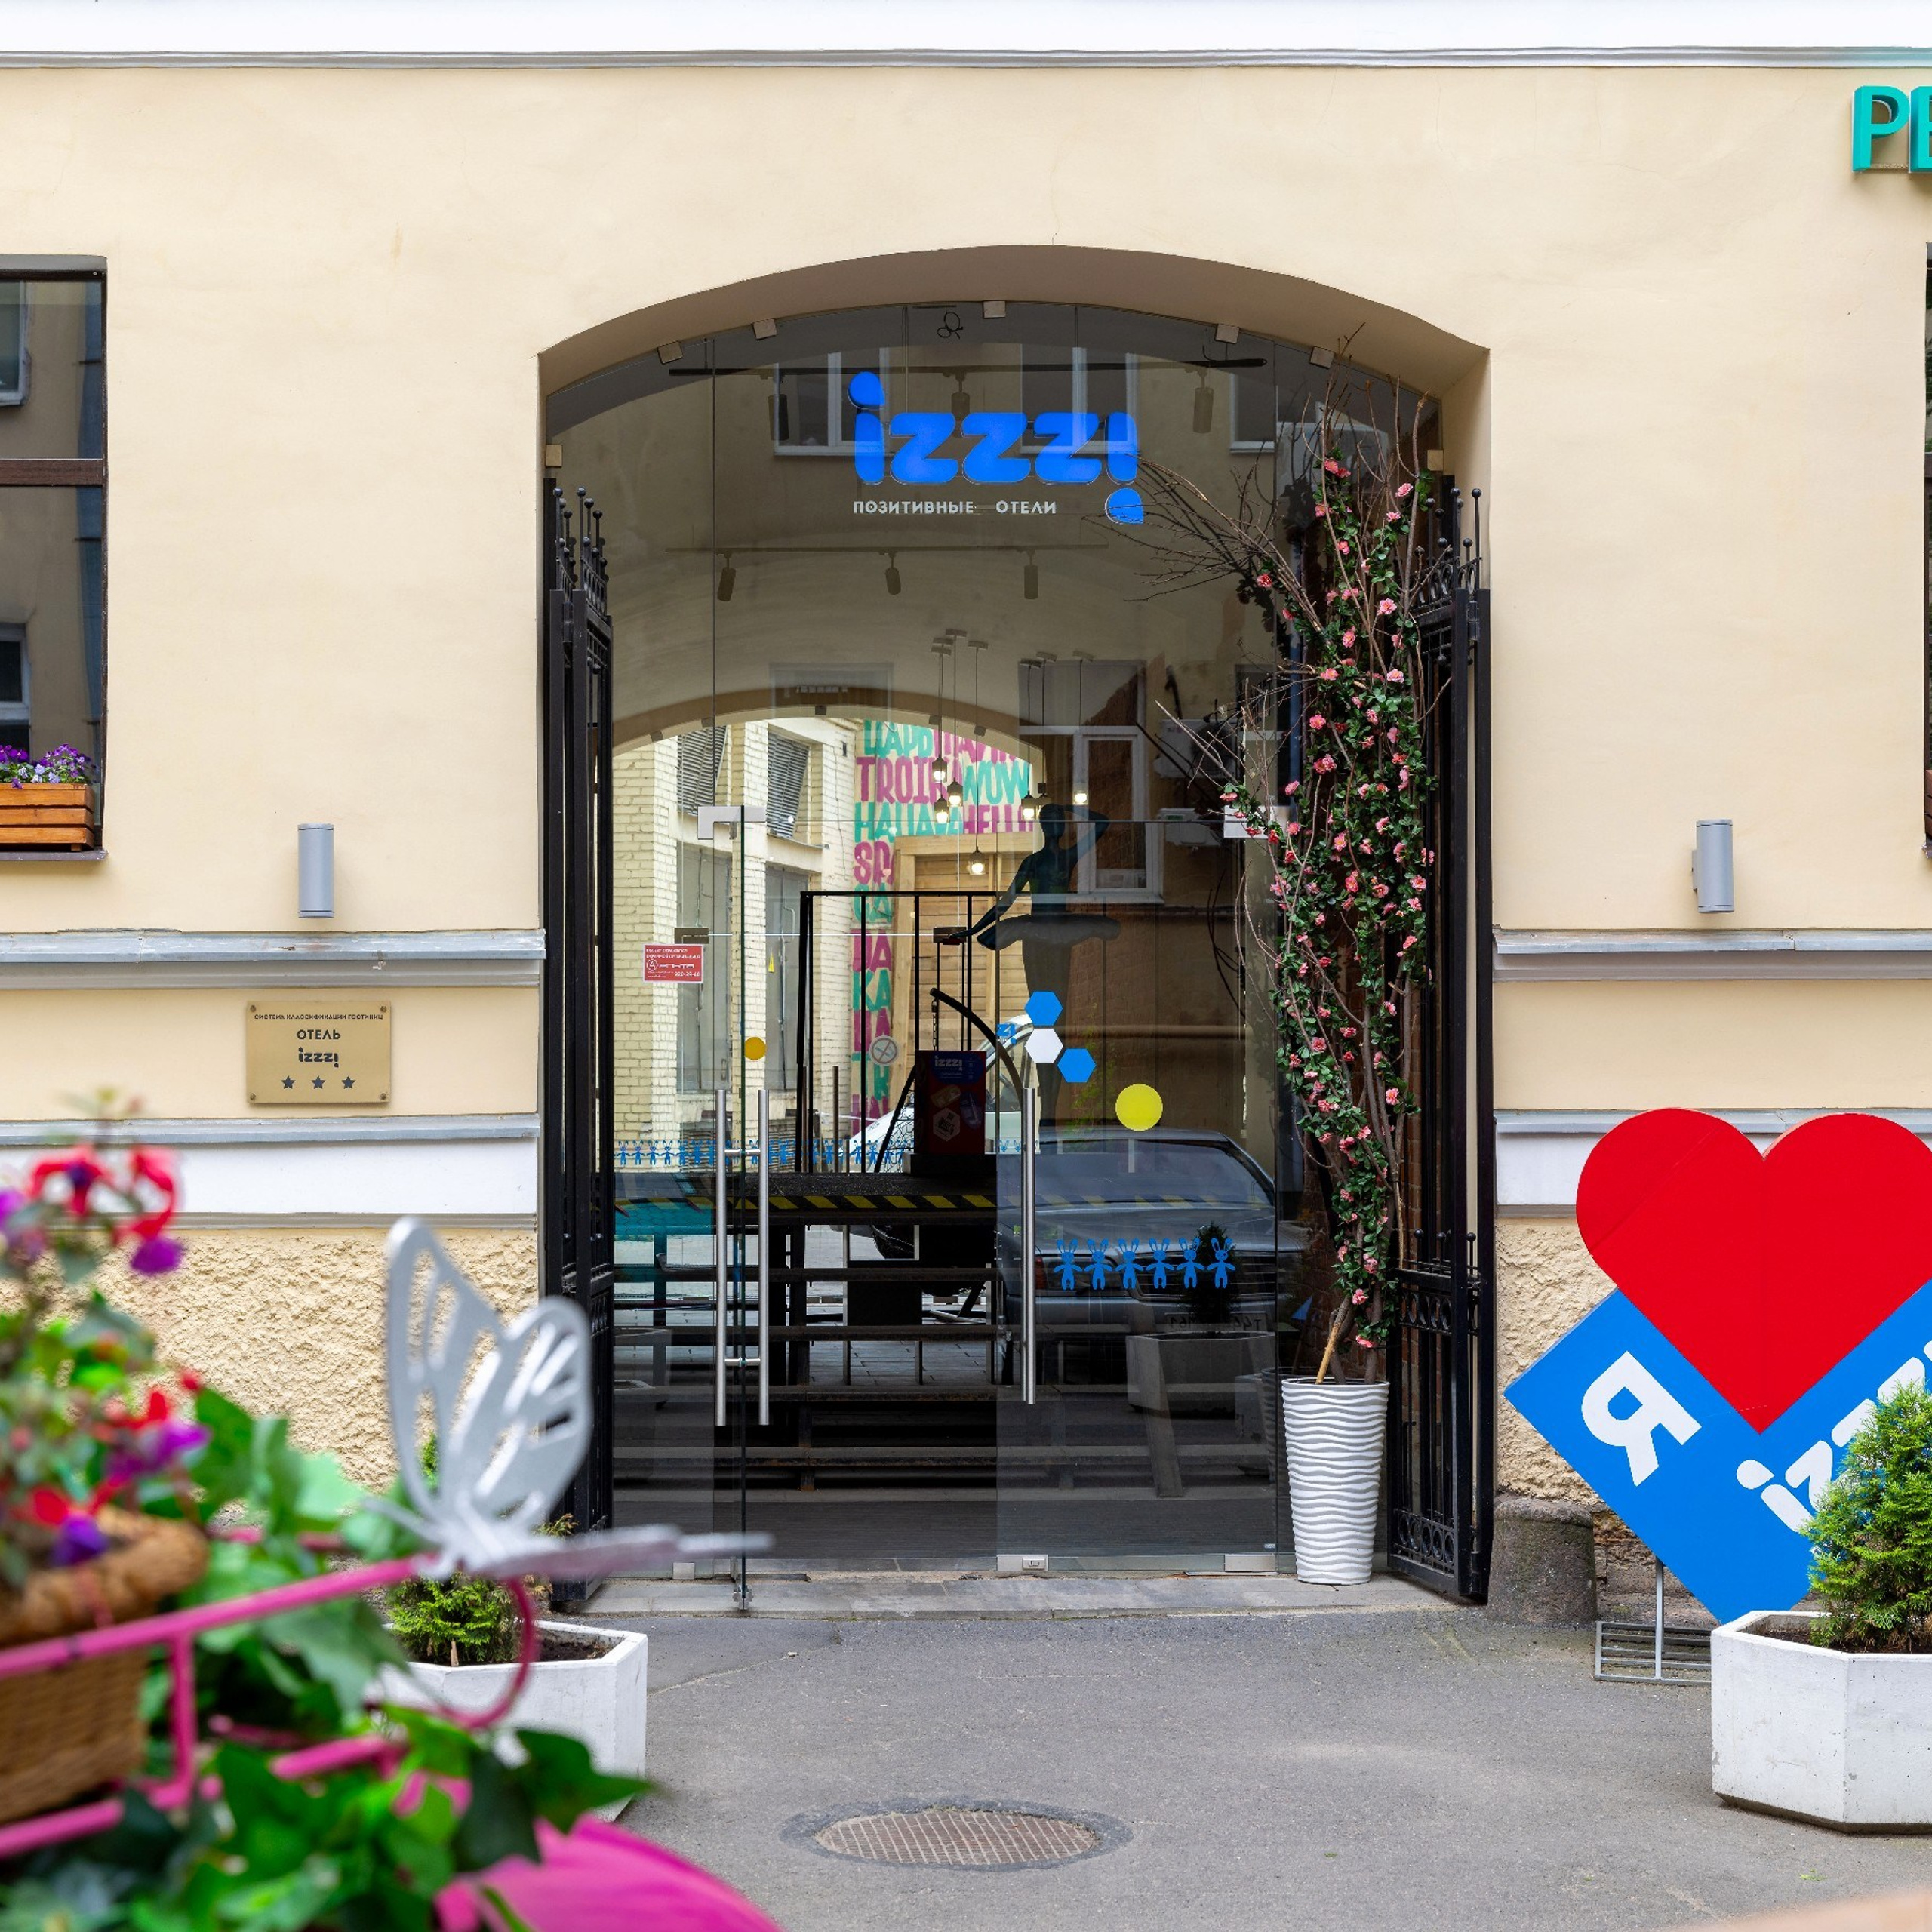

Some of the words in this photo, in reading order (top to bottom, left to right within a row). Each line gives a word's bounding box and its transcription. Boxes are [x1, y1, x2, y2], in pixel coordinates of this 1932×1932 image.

[853, 500, 974, 514] ПОЗИТИВНЫЕ
[995, 500, 1057, 514] ОТЕЛИ
[963, 761, 1032, 804] WOW
[297, 1029, 340, 1040] ОТЕЛЬ
